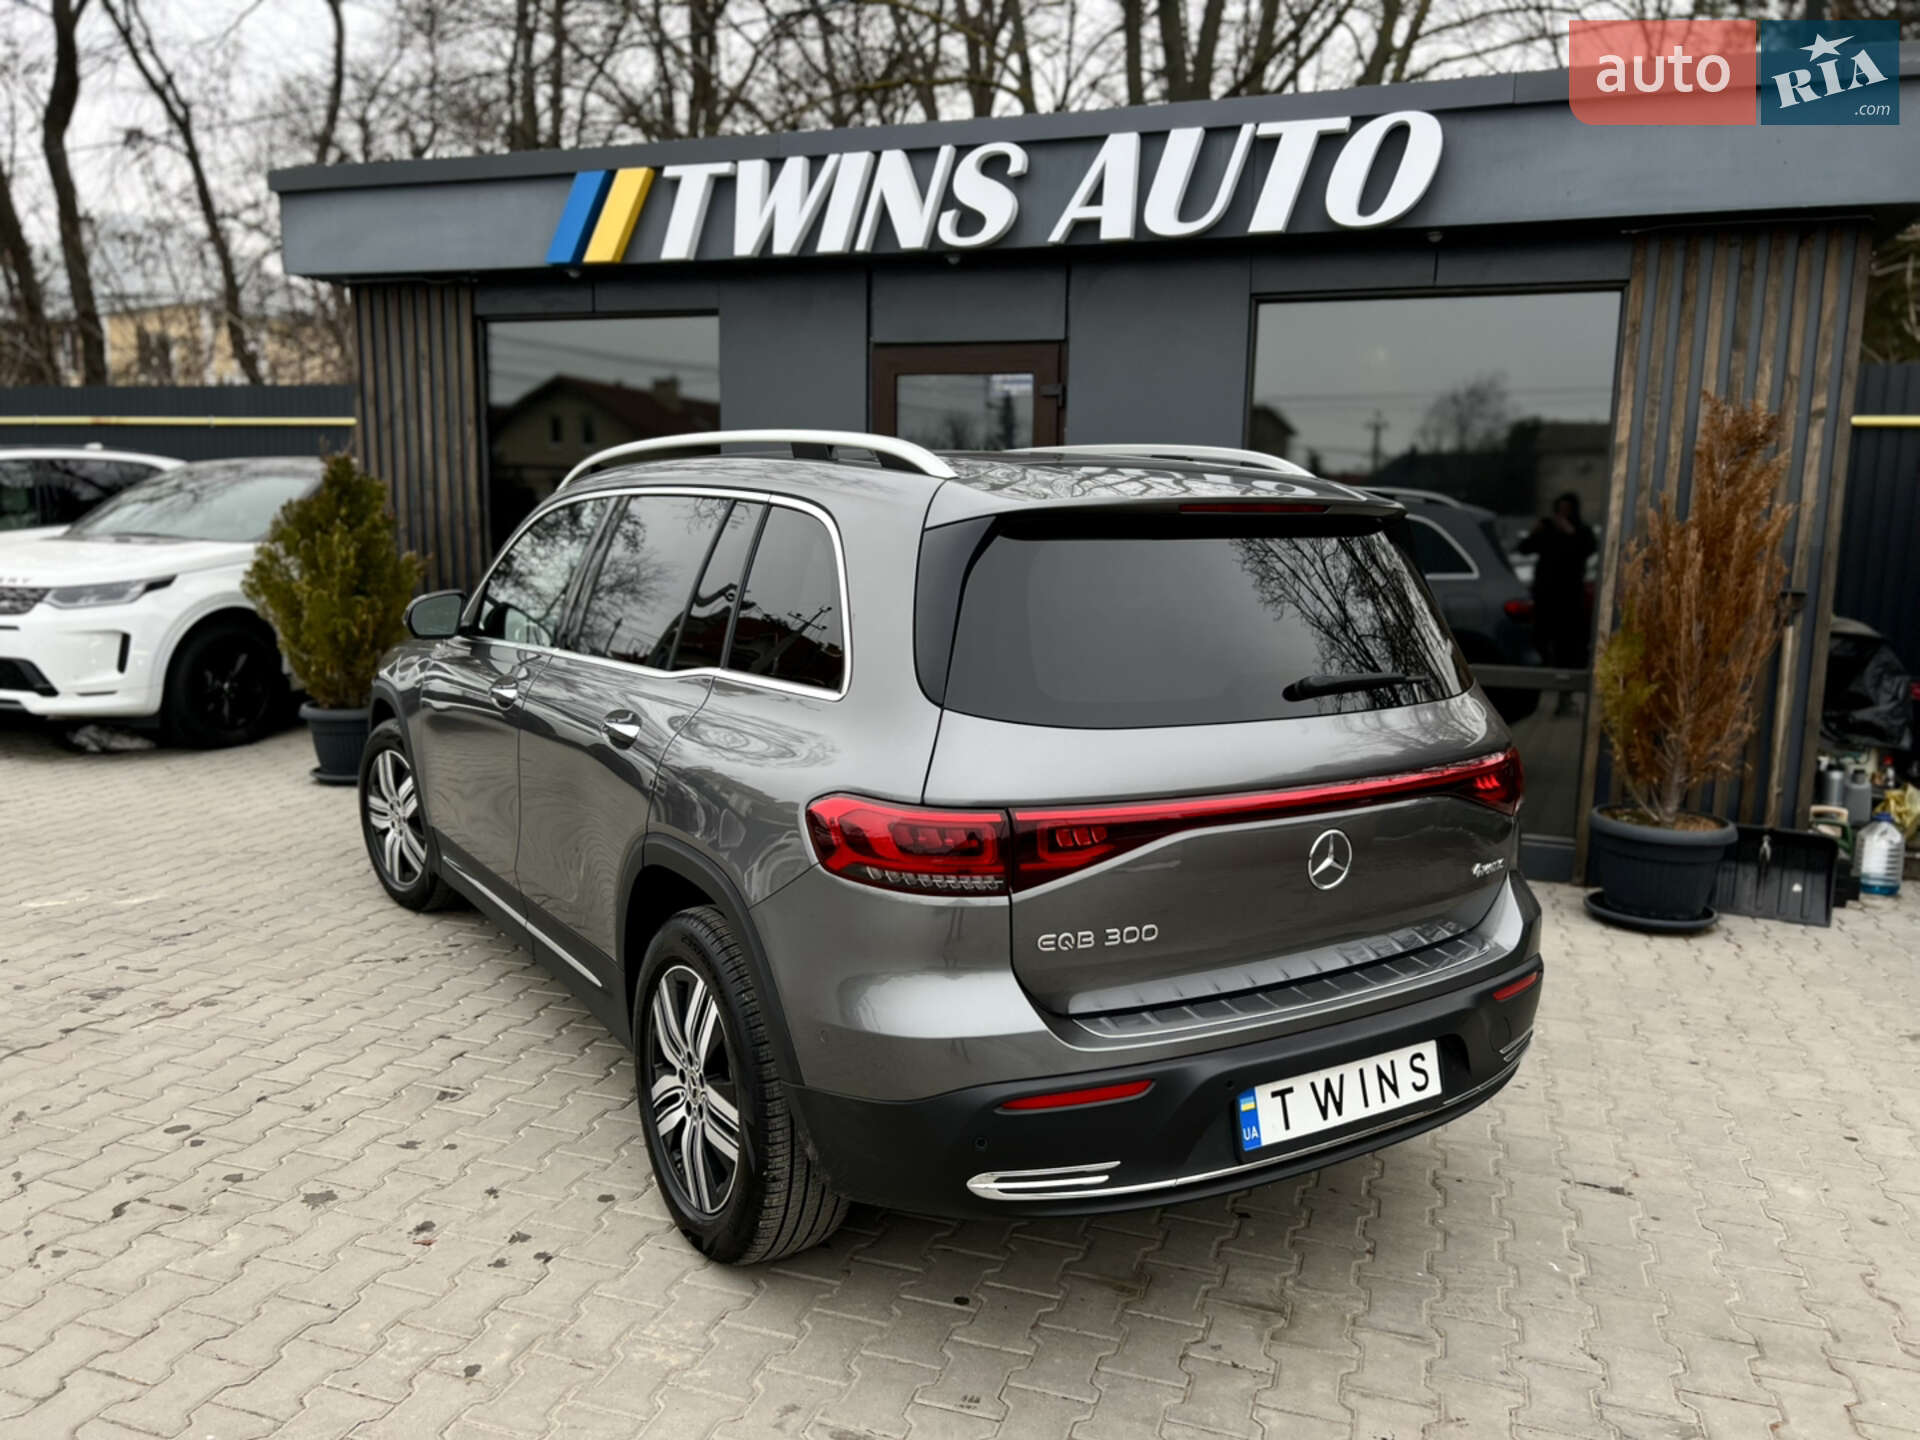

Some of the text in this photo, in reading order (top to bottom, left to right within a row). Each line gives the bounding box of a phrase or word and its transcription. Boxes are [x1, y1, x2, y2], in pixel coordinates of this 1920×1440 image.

[660, 110, 1444, 260] TWINS AUTO
[1037, 924, 1159, 951] EQB 300
[1243, 1127, 1259, 1140] UA
